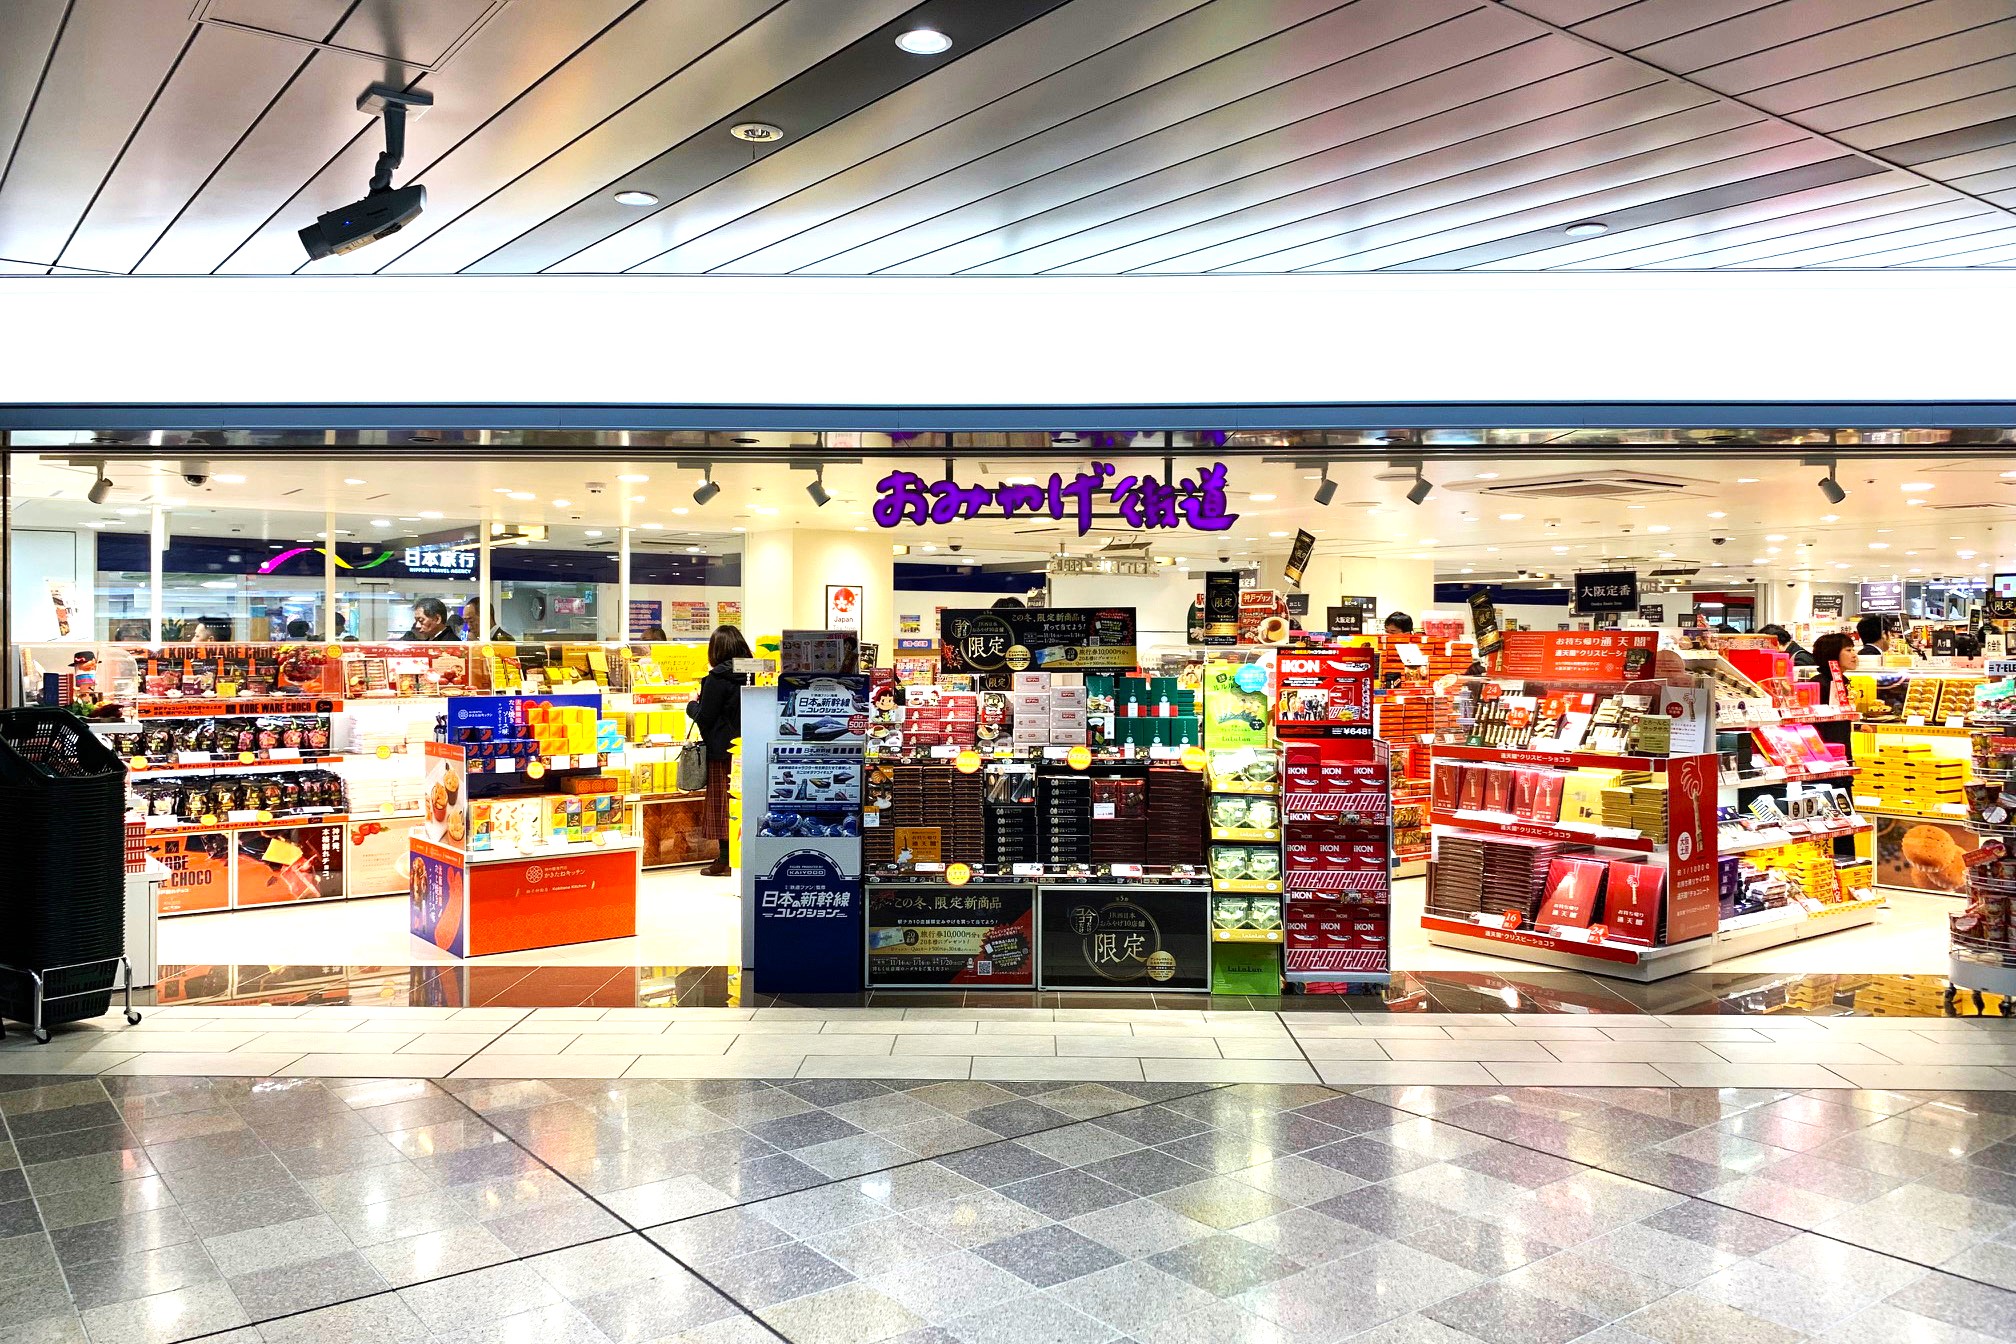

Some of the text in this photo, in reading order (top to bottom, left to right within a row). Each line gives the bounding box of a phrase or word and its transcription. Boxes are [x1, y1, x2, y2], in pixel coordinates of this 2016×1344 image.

[873, 461, 1240, 536] おみやげ街道
[405, 551, 475, 568] 日本旅行
[1581, 585, 1631, 598] 大阪定番
[1214, 598, 1232, 608] 限定
[1243, 594, 1271, 602] 神戸プリン
[1994, 601, 2014, 610] 限定
[968, 636, 1006, 658] 限定
[1556, 638, 1601, 646] お持ち帰り
[170, 646, 200, 659] KOBE
[207, 646, 242, 659] WARE
[1281, 660, 1320, 672] iKON
[988, 678, 1006, 687] 限定
[239, 703, 311, 713] KOBE WARE CHOCO
[799, 698, 850, 707] 日本の新幹線
[171, 870, 212, 887] CHOCO
[544, 869, 585, 878] かきたねキッチン
[762, 891, 850, 907] 日本の新幹線
[894, 896, 1002, 910] この冬、限定新商品
[774, 909, 840, 917] コレクション
[1506, 913, 1516, 922] 16
[1094, 933, 1148, 963] 限定
